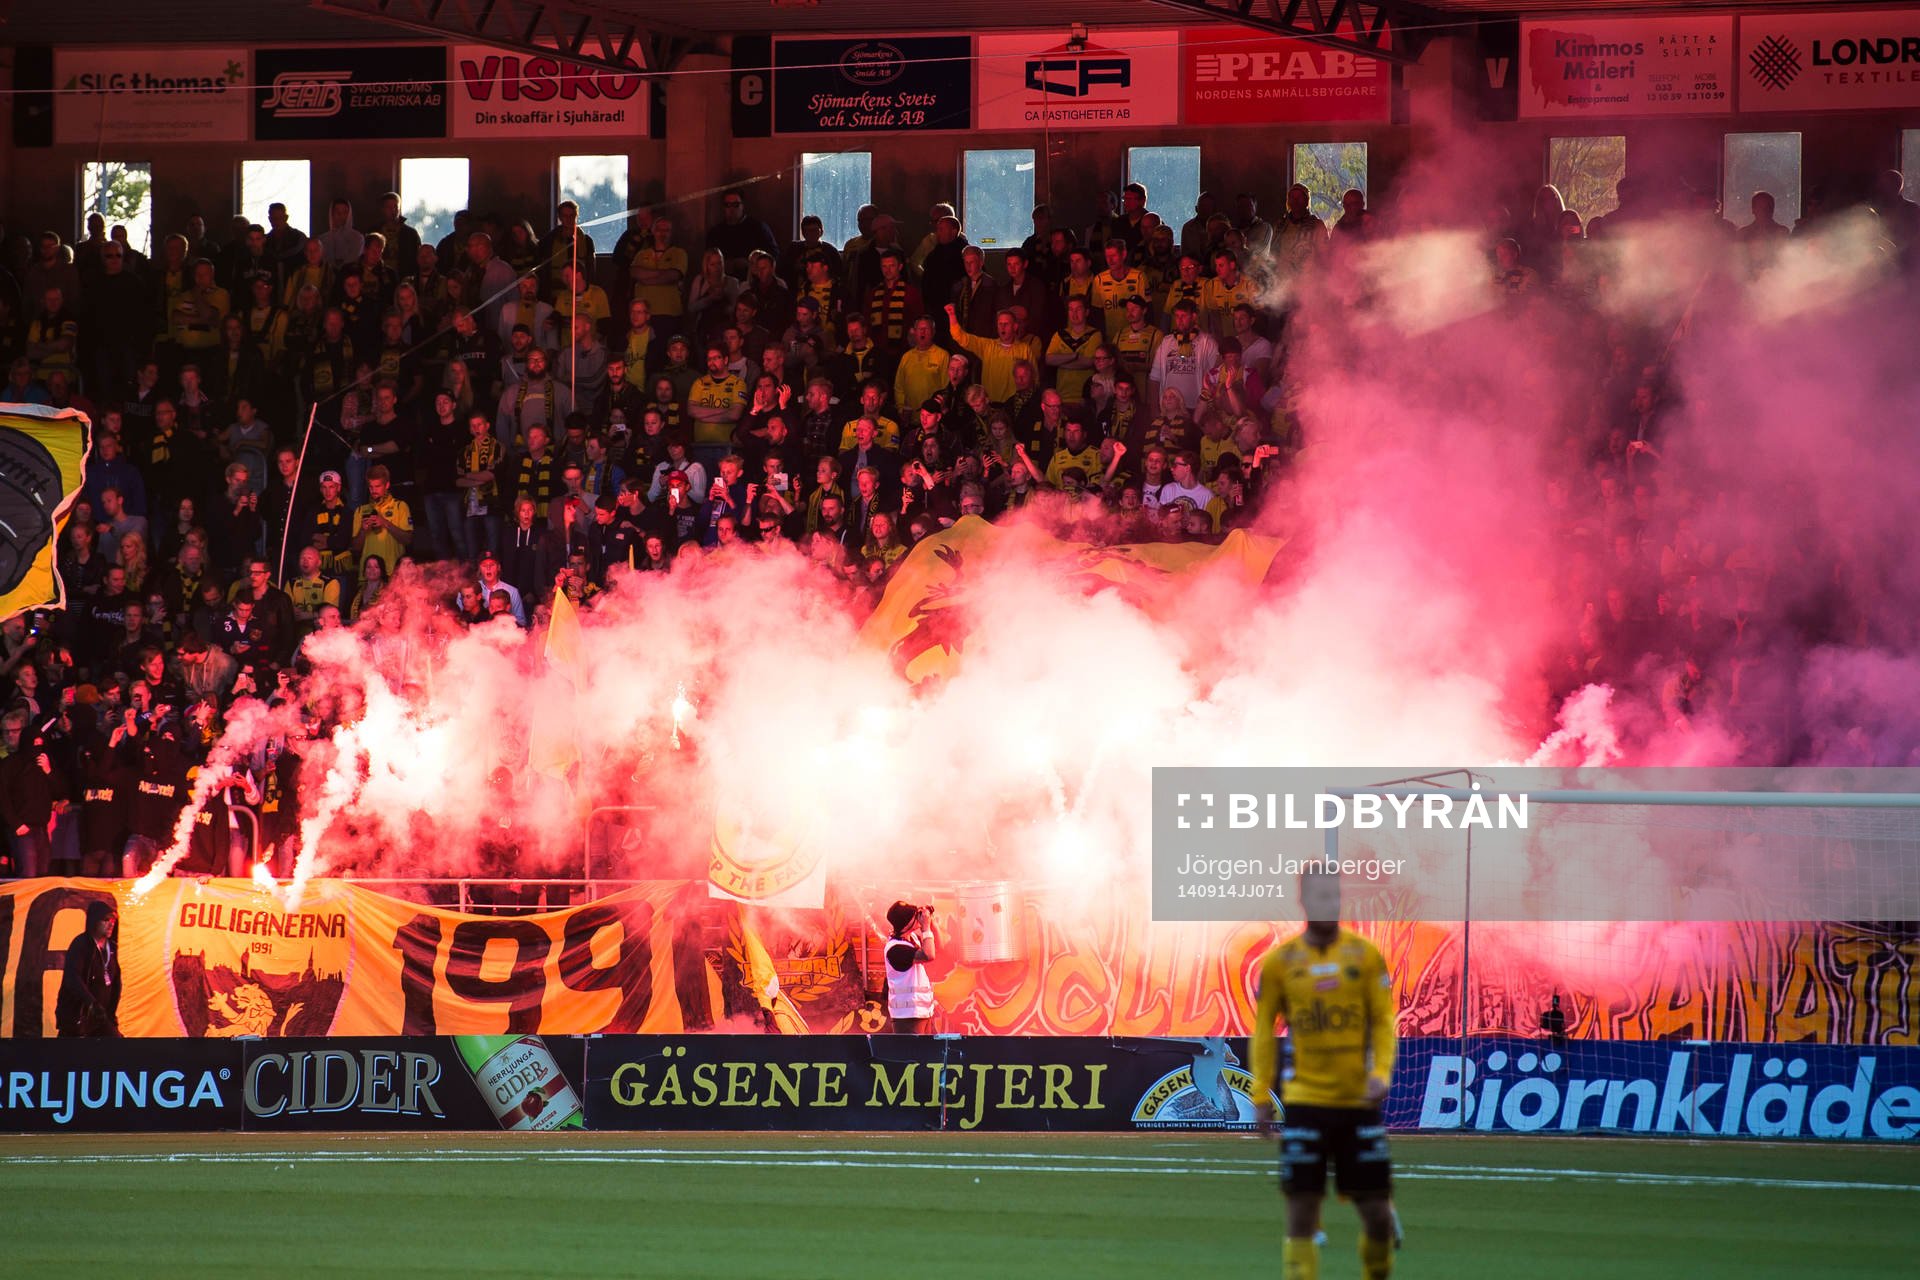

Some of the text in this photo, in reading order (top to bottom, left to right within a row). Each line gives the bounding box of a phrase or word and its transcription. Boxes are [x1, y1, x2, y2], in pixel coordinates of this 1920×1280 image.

[1554, 39, 1645, 58] Kimmos
[1659, 34, 1699, 46] RÄTT
[1663, 47, 1714, 58] SLÄTT
[1215, 50, 1356, 82] PEAB
[1563, 60, 1636, 80] Måleri
[350, 94, 441, 107] ELEKTRISKA AB
[1196, 86, 1377, 100] NORDENS SAMHÄLLSBYGGARE
[1567, 94, 1630, 105] Entreprenad
[807, 91, 937, 114] Sjömarkens Svets
[475, 112, 498, 125] Din
[500, 111, 553, 125] skoaffär
[564, 110, 625, 126] Sjuhärad!
[819, 109, 925, 127] och Smide AB
[1024, 109, 1131, 121] CA FASTIGHETER AB
[700, 394, 731, 409] ellos
[223, 621, 232, 632] 3
[179, 901, 346, 938] GULIGANERNA
[250, 941, 273, 955] 1991
[487, 1050, 534, 1087] HERRLJUNGA
[244, 1048, 446, 1118] CIDER
[495, 1061, 545, 1105] CIDER
[610, 1046, 1108, 1130] GÄSENE MEJERI
